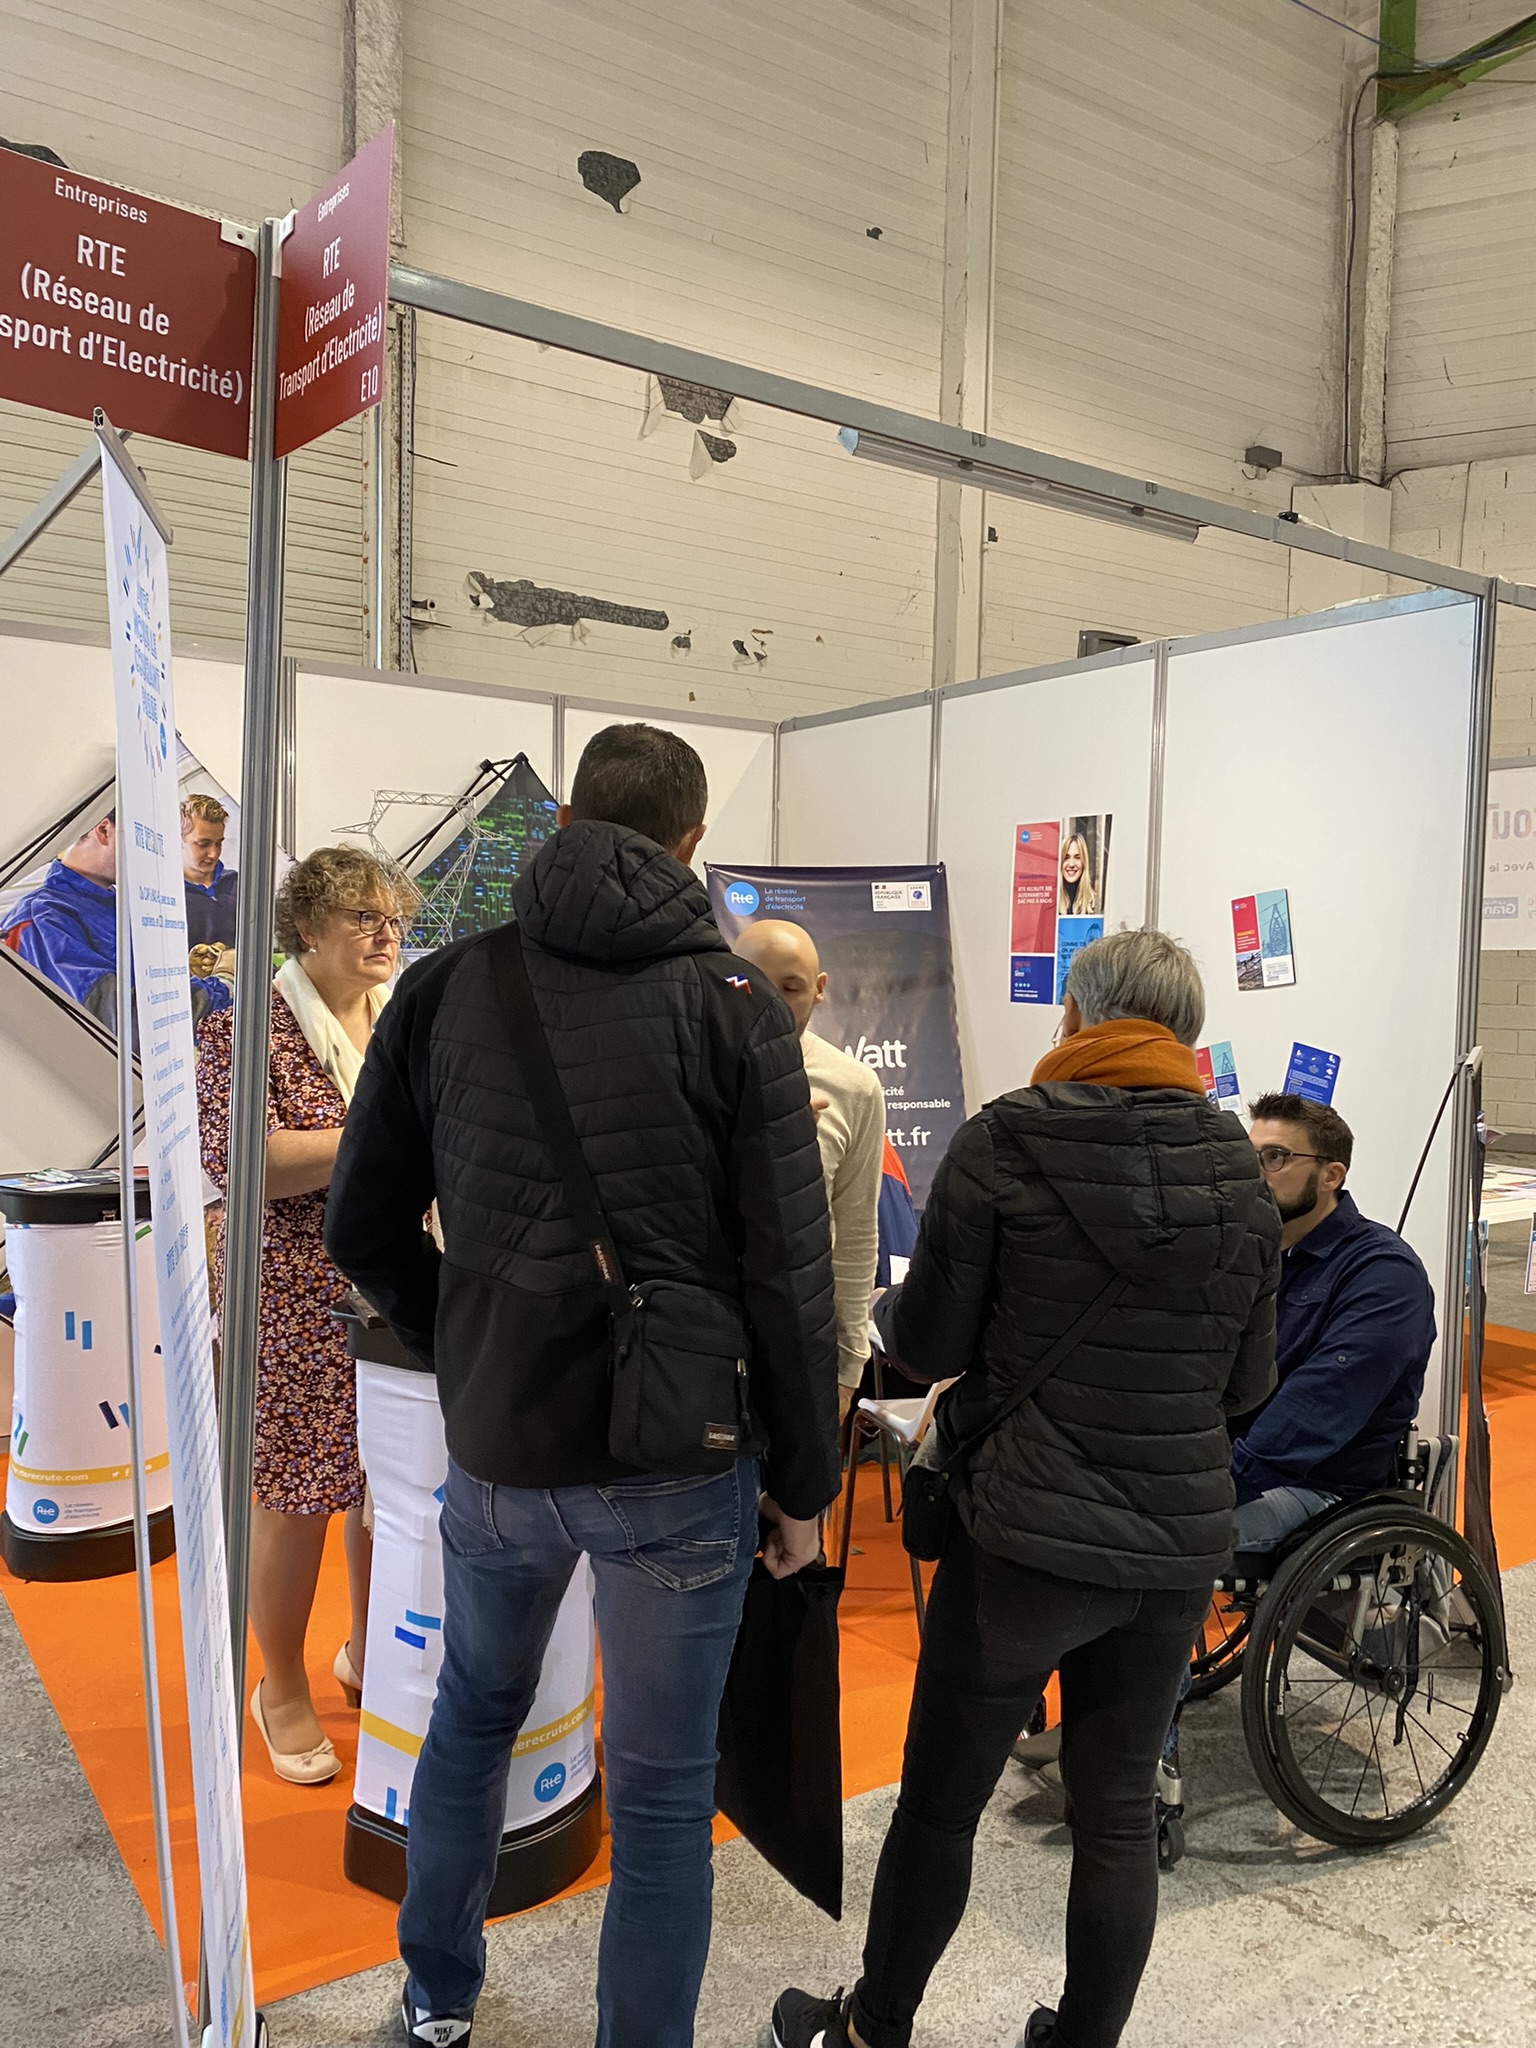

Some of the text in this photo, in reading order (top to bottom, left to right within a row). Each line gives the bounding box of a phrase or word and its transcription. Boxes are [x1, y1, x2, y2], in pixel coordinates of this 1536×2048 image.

[55, 177, 147, 224] Entreprises
[317, 182, 350, 222] Entreprises
[77, 234, 126, 277] RTE
[322, 237, 341, 279] RTE
[21, 262, 169, 335] (Réseau de
[304, 278, 355, 342] (Réseau de
[79, 331, 243, 405] d'Electricité)
[279, 301, 382, 401] Transport d'Electricité)
[360, 365, 379, 402] E10
[731, 892, 753, 904] Rte
[775, 896, 806, 904] transport
[887, 1099, 951, 1111] responsable
[37, 1506, 55, 1516] Rte
[541, 1773, 562, 1792] Rte
[434, 2025, 454, 2036] NIKE
